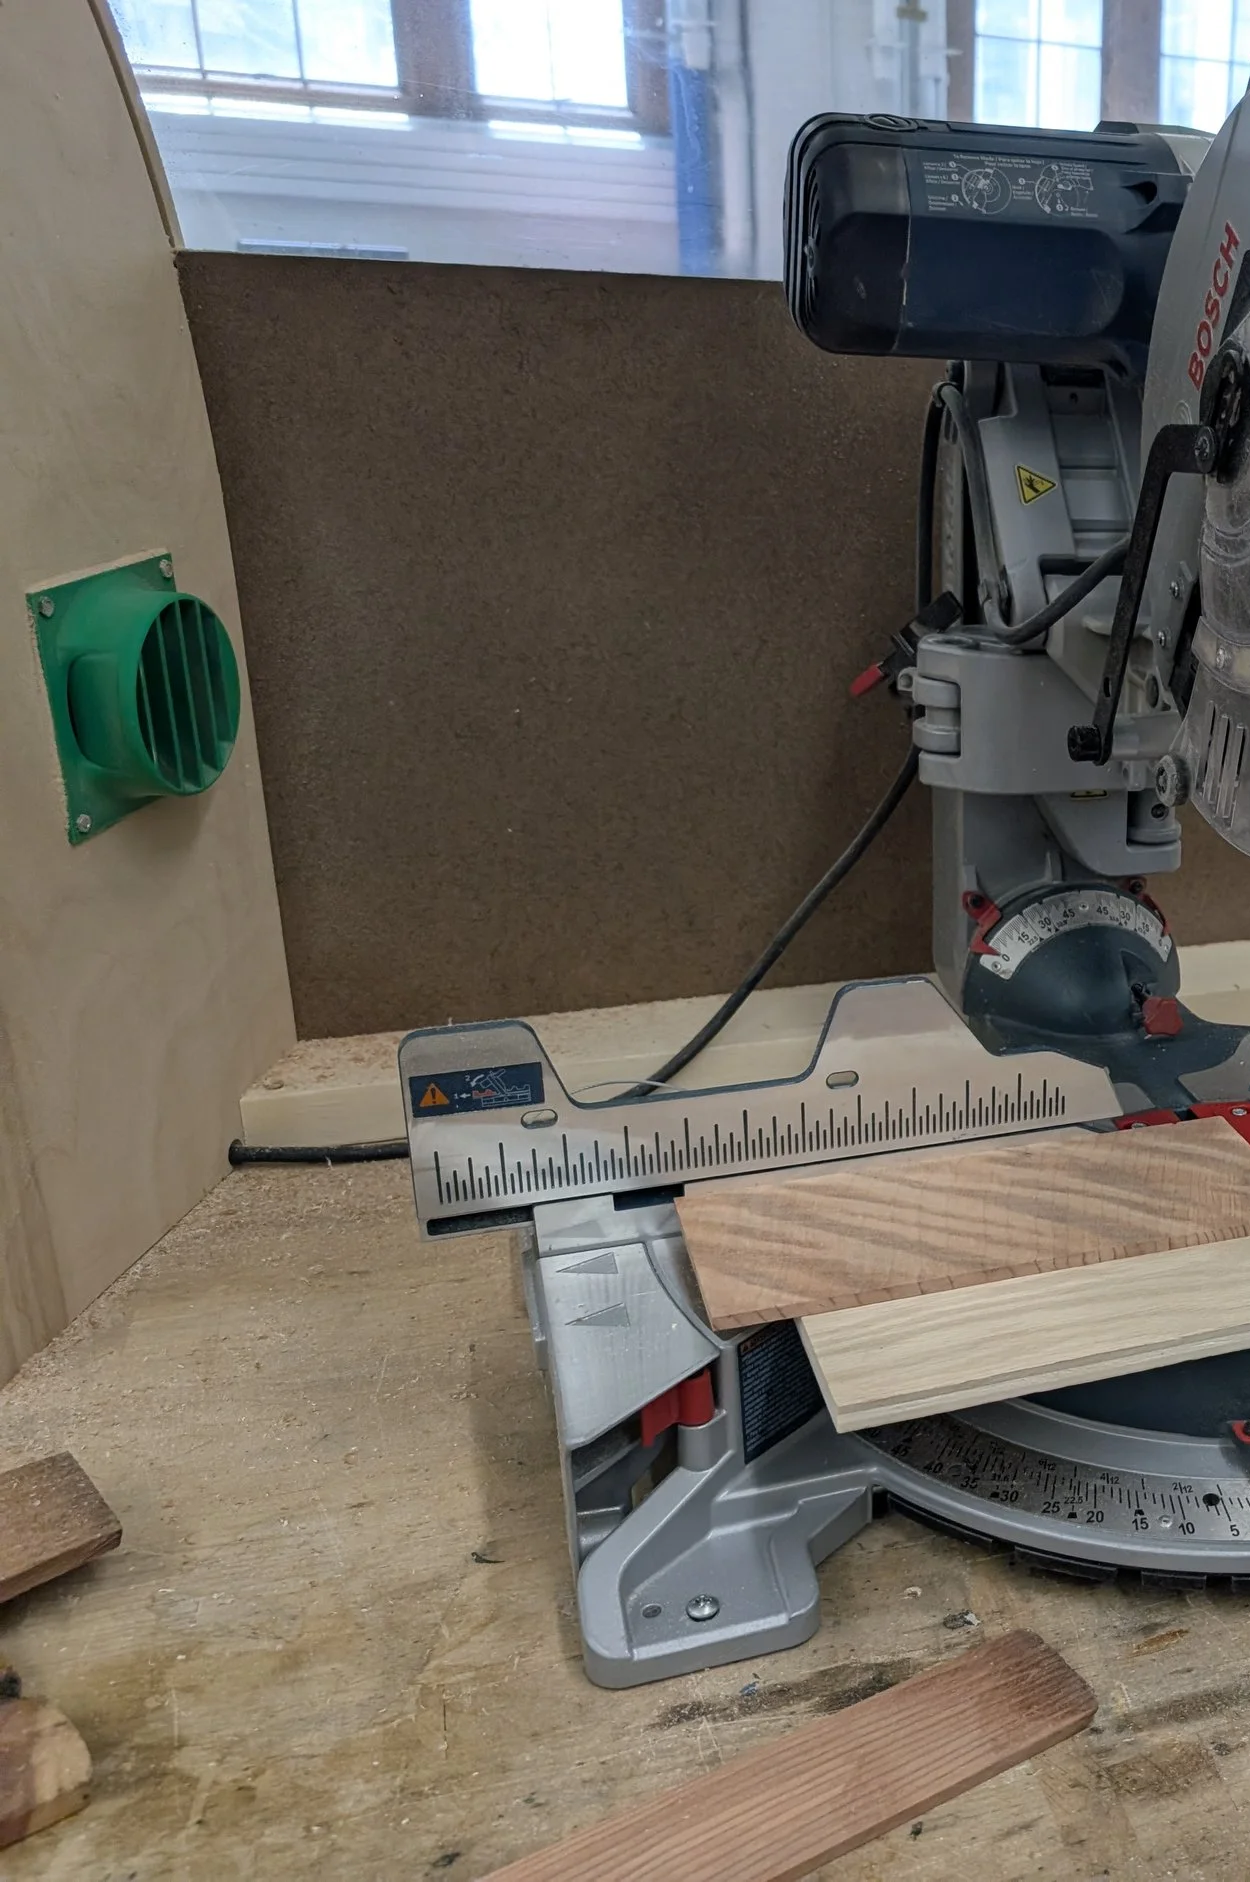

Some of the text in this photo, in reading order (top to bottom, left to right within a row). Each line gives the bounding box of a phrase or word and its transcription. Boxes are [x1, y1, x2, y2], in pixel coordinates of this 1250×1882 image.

[1188, 220, 1240, 391] BOSCH
[1001, 953, 1011, 962] 0
[1017, 931, 1030, 944] 15
[1038, 917, 1052, 930] 30
[1096, 905, 1109, 916] 45
[1120, 910, 1131, 921] 30
[922, 1461, 944, 1475] 40
[960, 1475, 981, 1489] 35
[1000, 1489, 1020, 1503] 30
[1042, 1500, 1061, 1514] 25
[1063, 1495, 1084, 1505] 22.5
[1086, 1510, 1105, 1524] 20
[1131, 1516, 1150, 1531] 15
[1178, 1521, 1196, 1536] 10
[1229, 1524, 1241, 1537] 5
